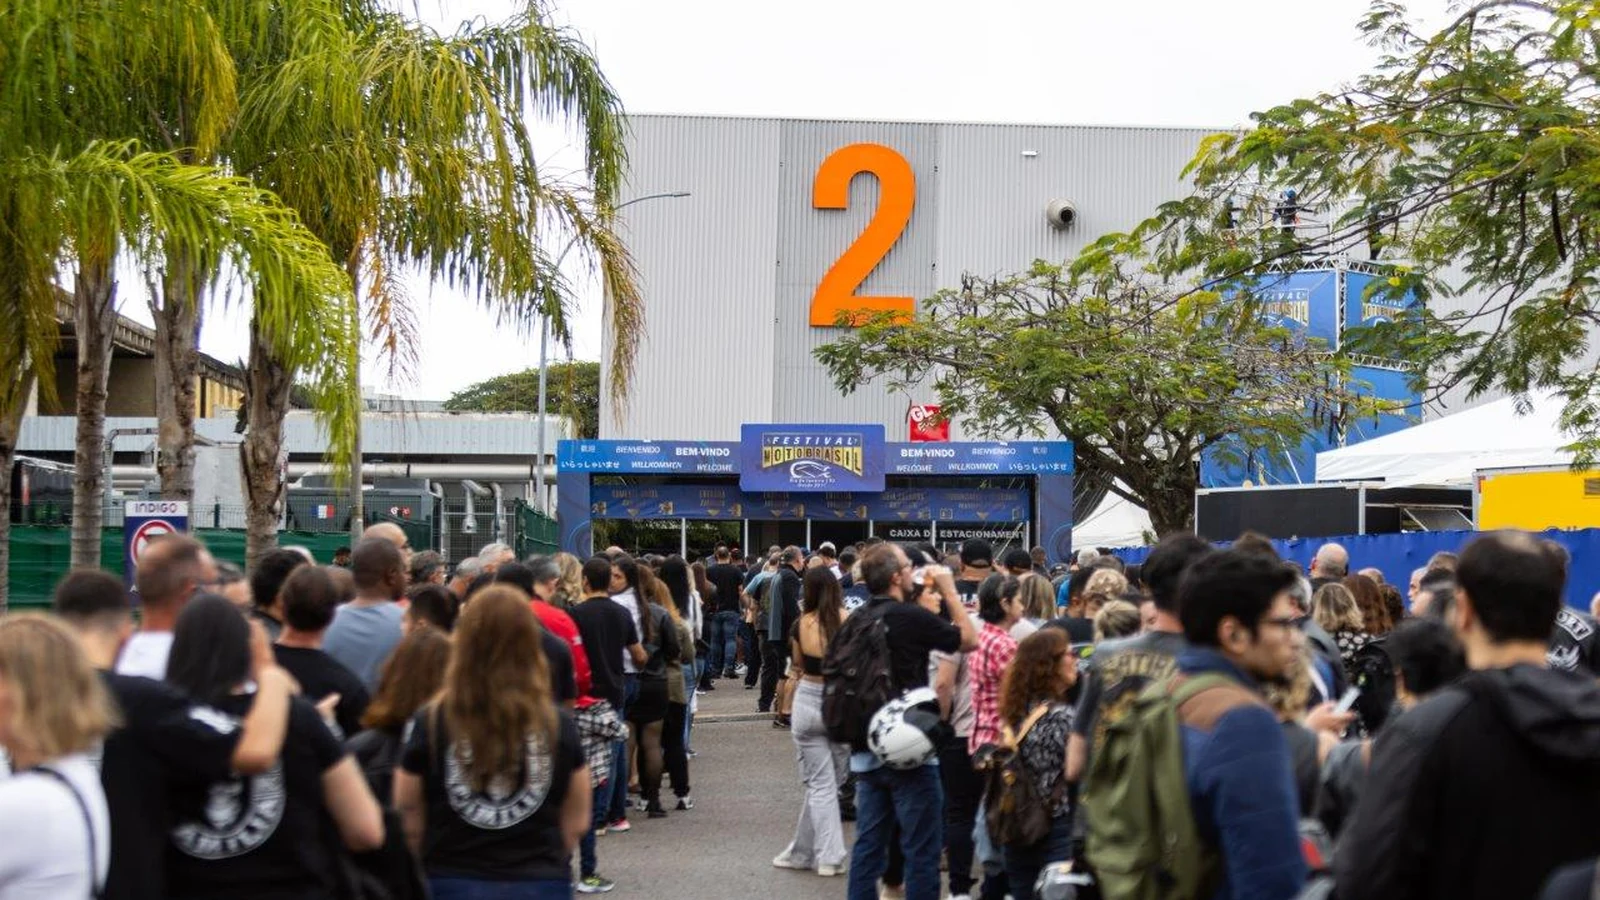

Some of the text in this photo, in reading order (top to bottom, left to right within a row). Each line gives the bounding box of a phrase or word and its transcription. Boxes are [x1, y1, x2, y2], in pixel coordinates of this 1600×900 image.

[810, 142, 916, 328] 2
[772, 436, 853, 445] FESTIVAL
[616, 445, 660, 454] BIENVENIDO
[675, 447, 730, 456] BEM-VINDO
[901, 449, 955, 457] BEM-VINDO
[972, 447, 1016, 455] BIENVENIDO
[764, 447, 861, 472] MOTOBRASIL
[561, 460, 620, 469] いらっしゃいませ
[631, 461, 682, 470] WILLKOMMEN
[696, 463, 733, 471] WELCOME
[896, 464, 933, 472] WELCOME
[948, 461, 999, 470] WILLKOMMEN
[1009, 462, 1067, 471] いらっしゃいませ
[135, 502, 177, 513] INDIGO
[889, 529, 921, 538] CAIXA
[939, 530, 1023, 539] ESTACIONAMENT
